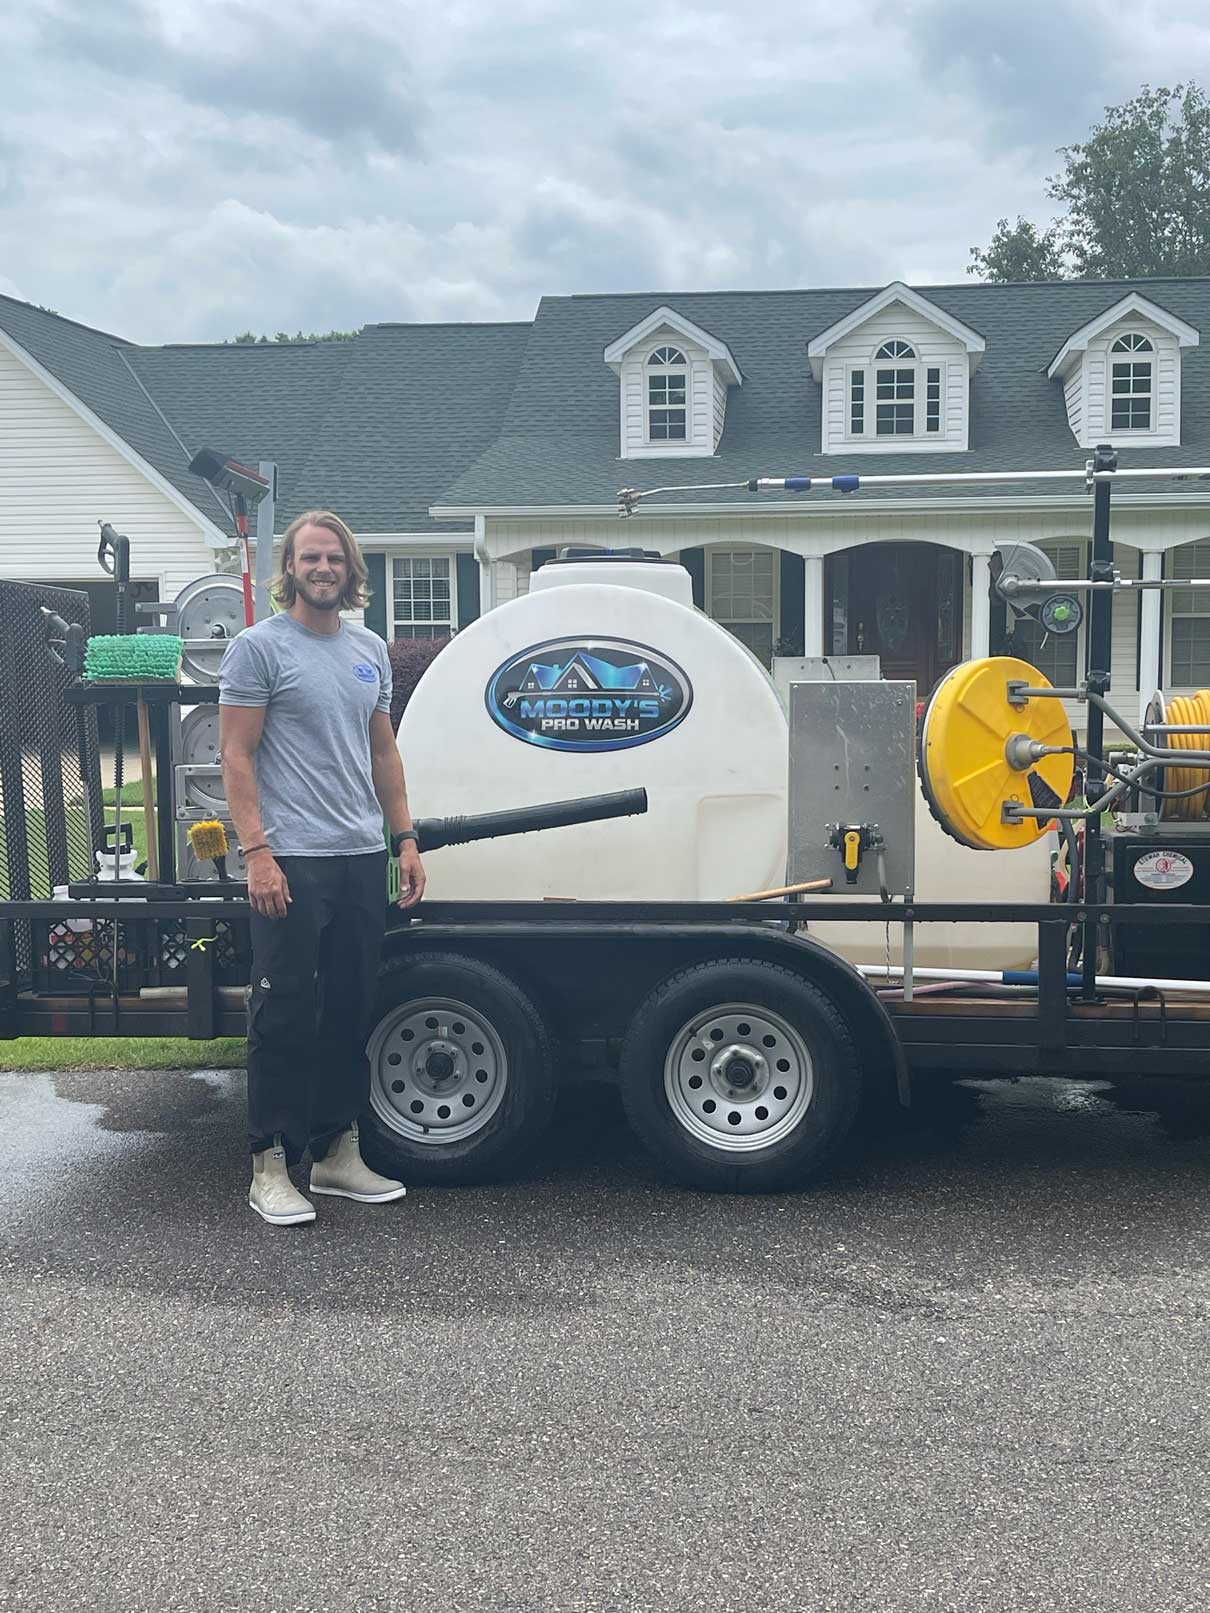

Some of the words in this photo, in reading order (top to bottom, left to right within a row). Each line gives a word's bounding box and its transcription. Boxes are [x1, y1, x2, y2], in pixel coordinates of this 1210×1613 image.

[520, 699, 659, 718] MOODY'S
[541, 719, 579, 730] PRO
[585, 719, 640, 730] WASH
